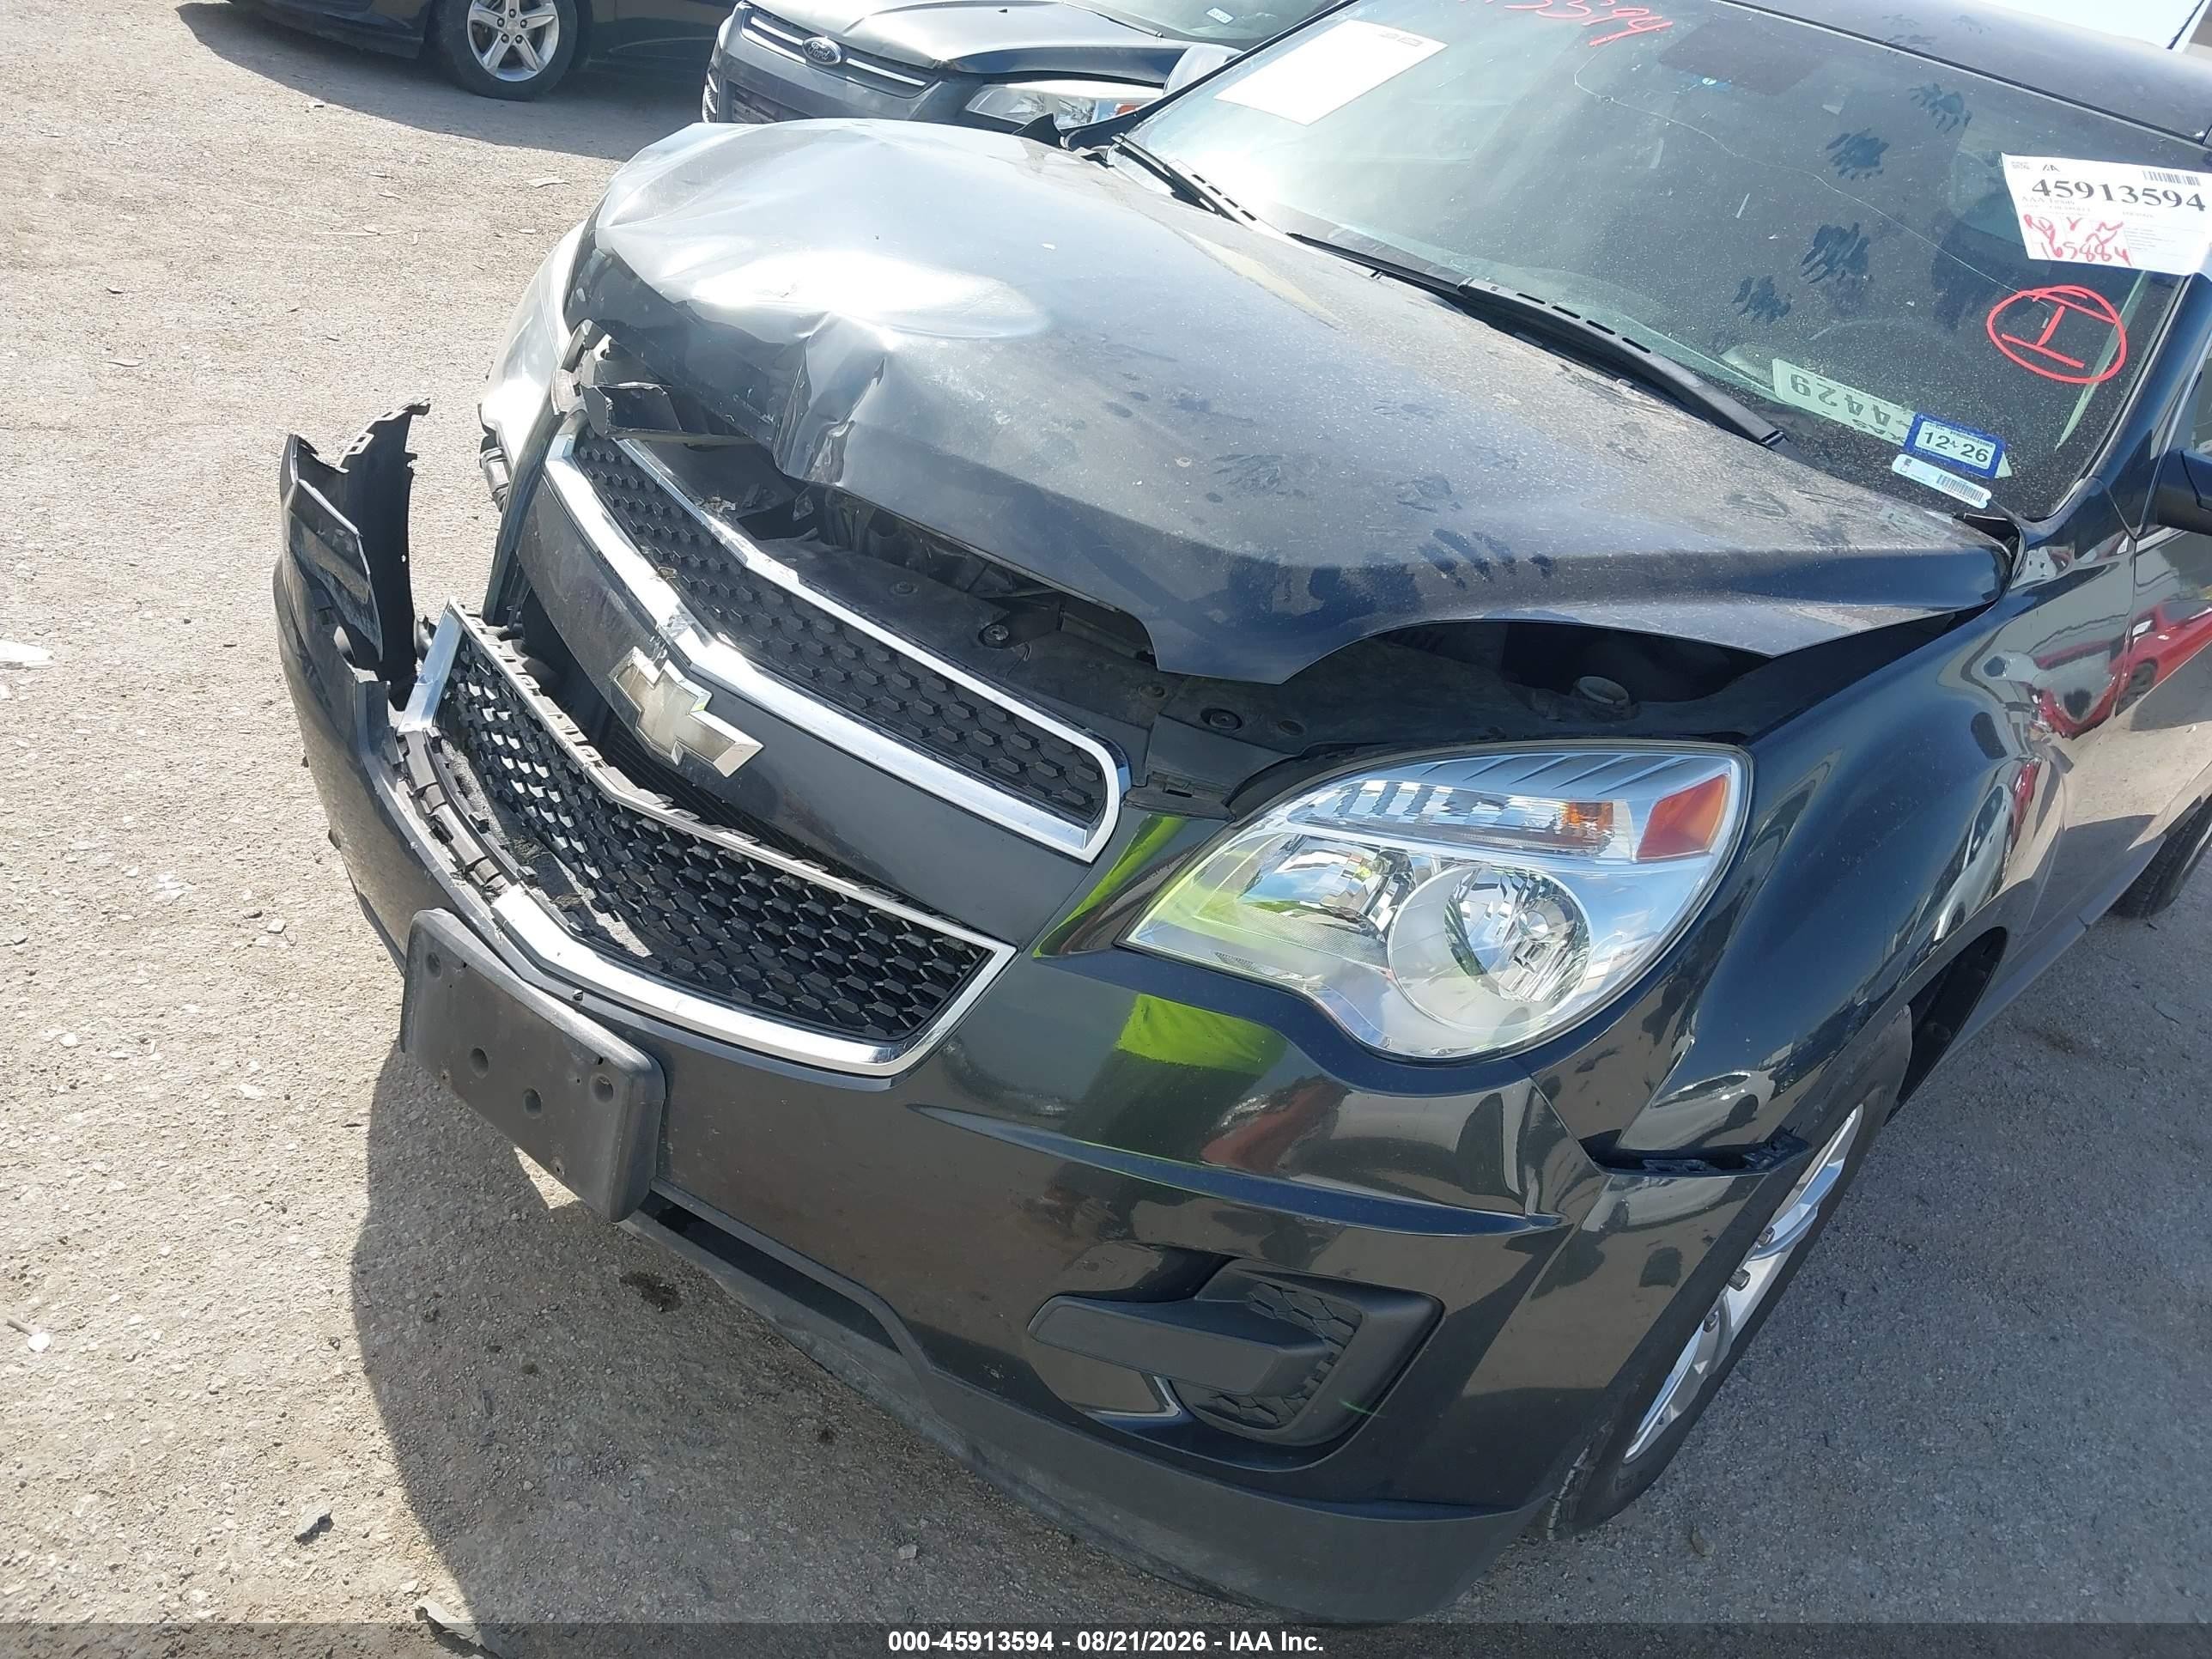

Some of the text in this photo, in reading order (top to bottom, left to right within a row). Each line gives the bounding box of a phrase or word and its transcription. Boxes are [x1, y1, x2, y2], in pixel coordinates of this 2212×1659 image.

[807, 41, 830, 60] Ford
[2032, 179, 2206, 212] 45913594
[1924, 431, 1950, 450] 12
[1960, 443, 1990, 463] 26
